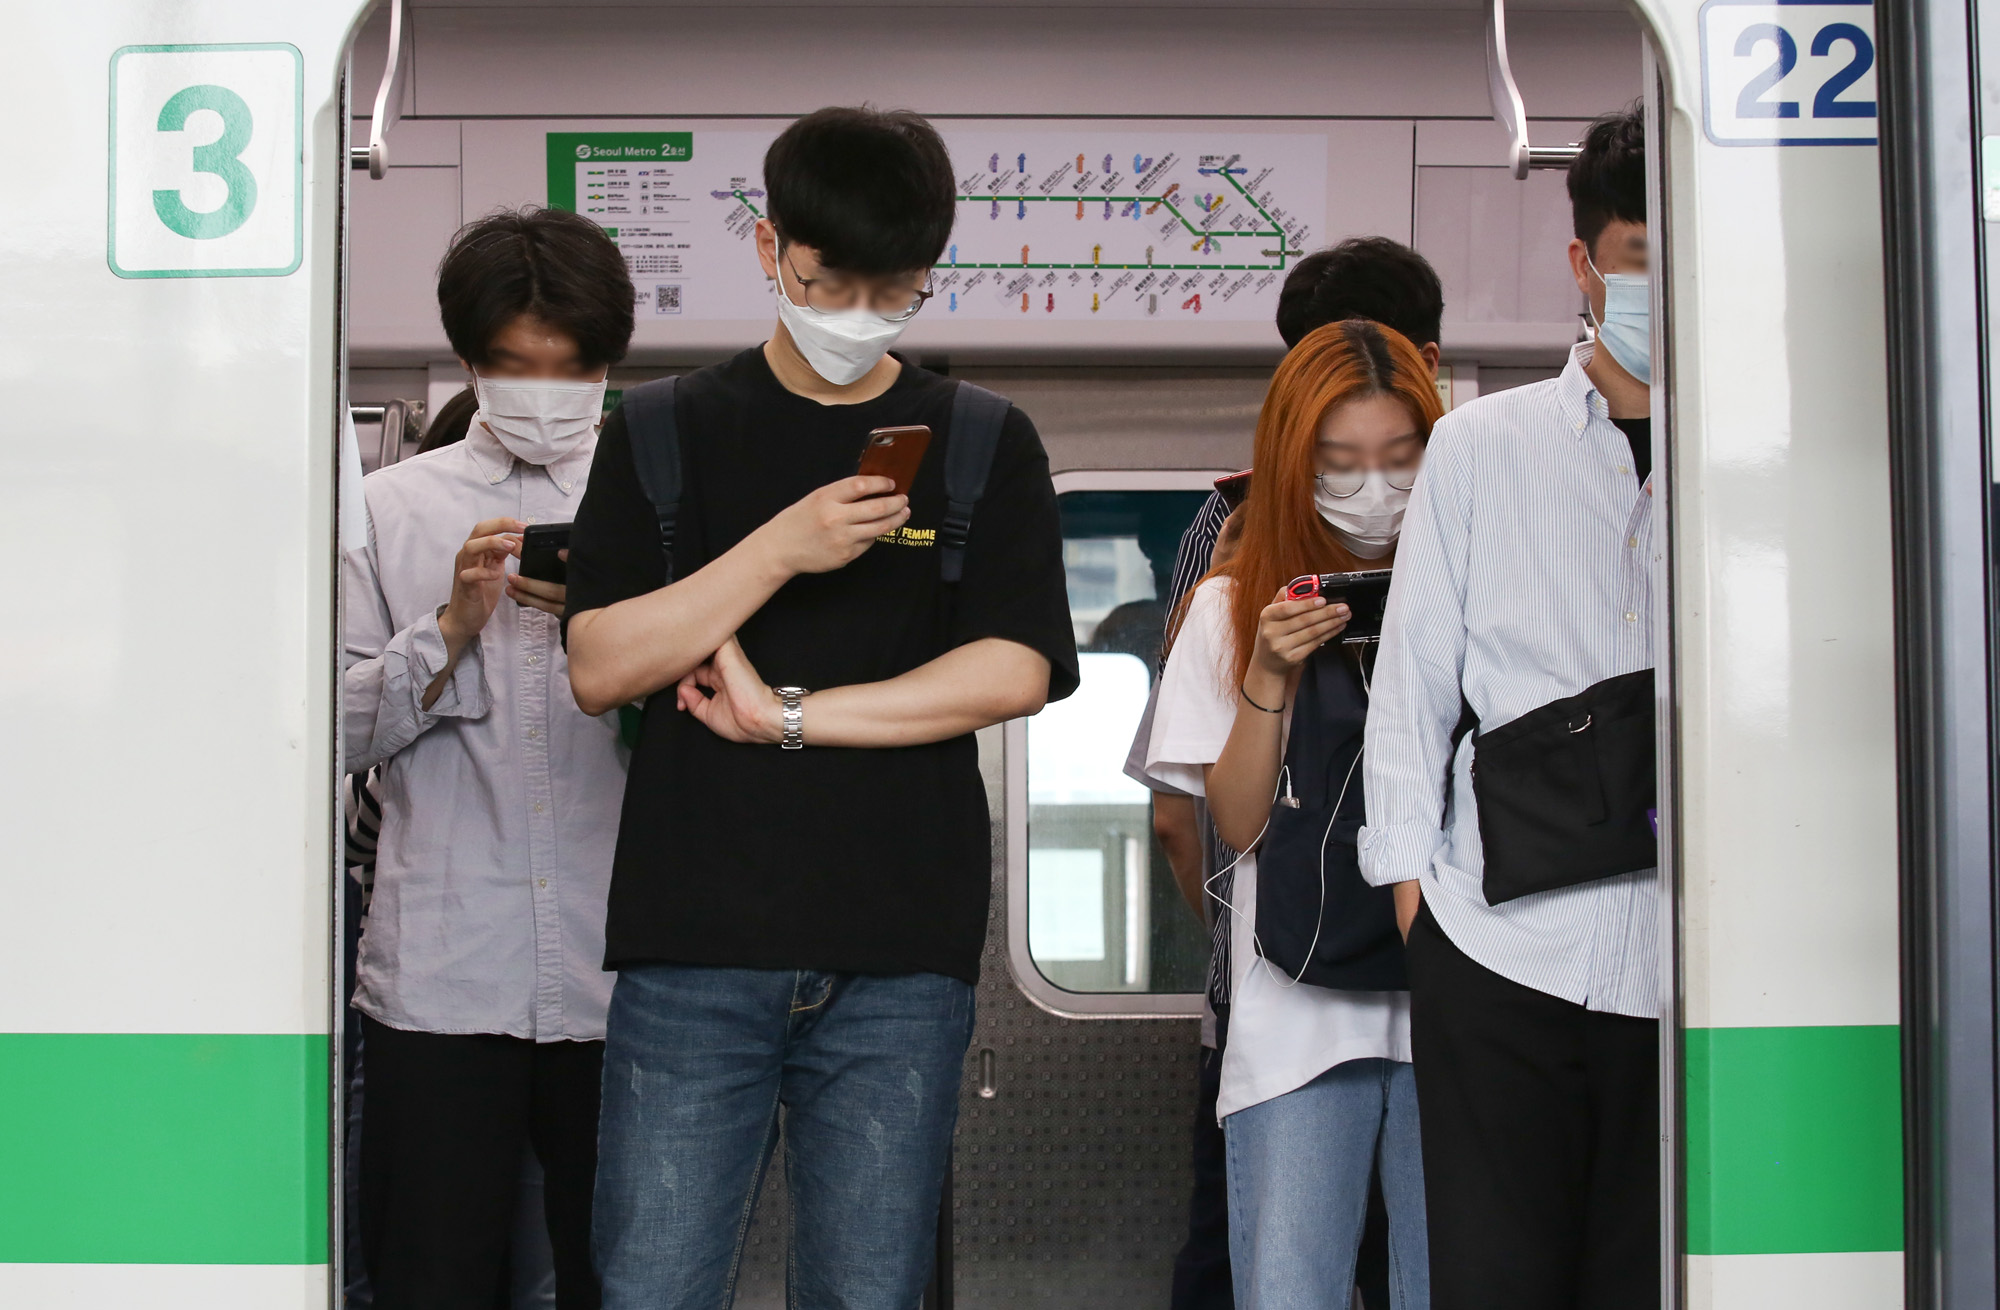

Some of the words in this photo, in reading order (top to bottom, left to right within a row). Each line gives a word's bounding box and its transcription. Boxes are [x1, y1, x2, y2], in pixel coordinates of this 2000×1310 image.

[1733, 23, 1877, 119] 22
[152, 84, 257, 240] 3
[593, 146, 622, 156] Seoul
[625, 146, 657, 156] Metro
[897, 538, 934, 547] COMPANY
